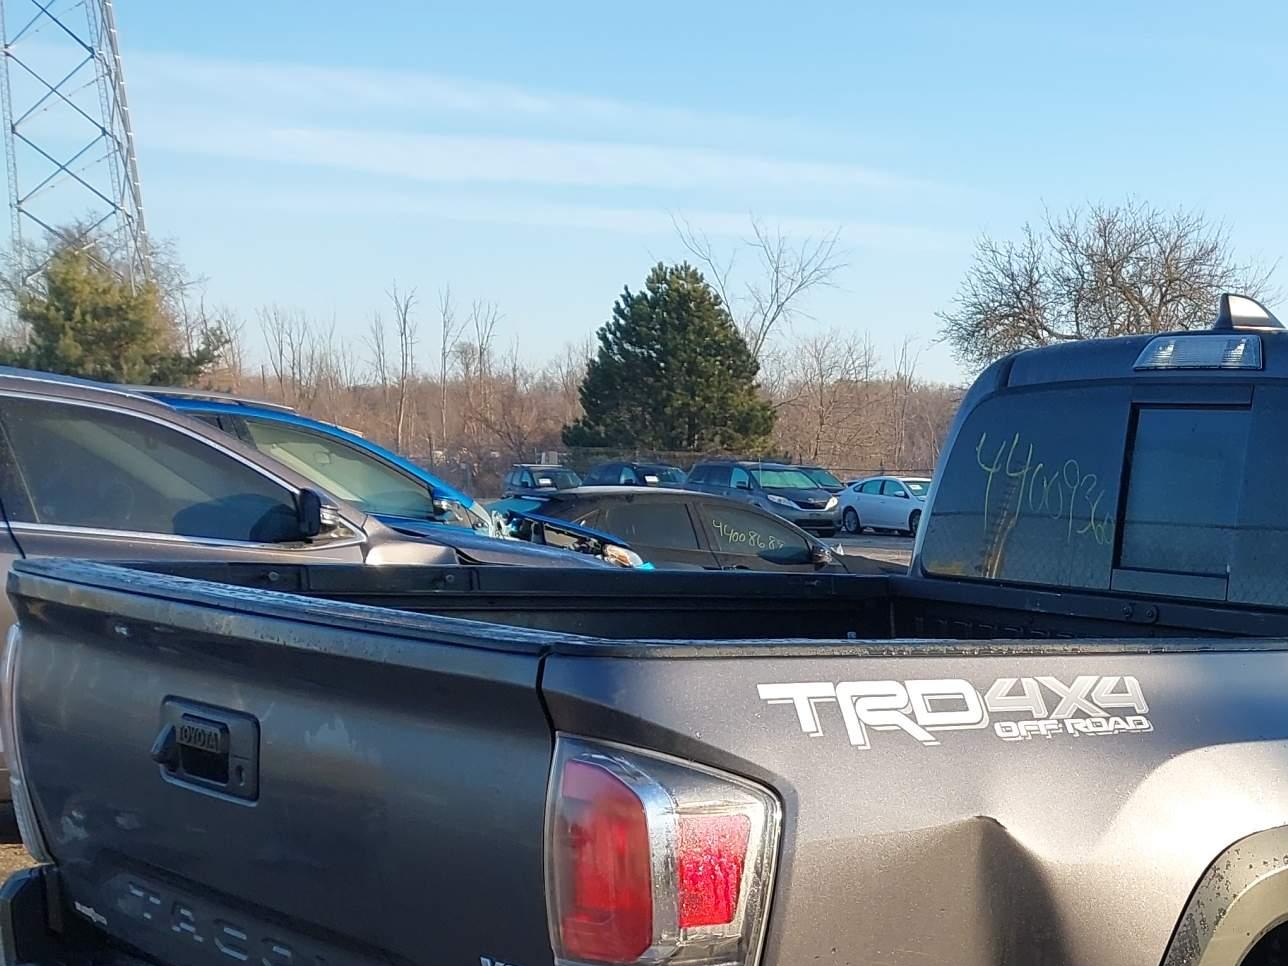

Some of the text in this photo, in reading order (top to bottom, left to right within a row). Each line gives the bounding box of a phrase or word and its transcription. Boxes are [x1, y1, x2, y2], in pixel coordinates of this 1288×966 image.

[756, 678, 990, 750] TRD
[993, 714, 1154, 742] OFF ROAD
[176, 725, 222, 753] TOYOTA
